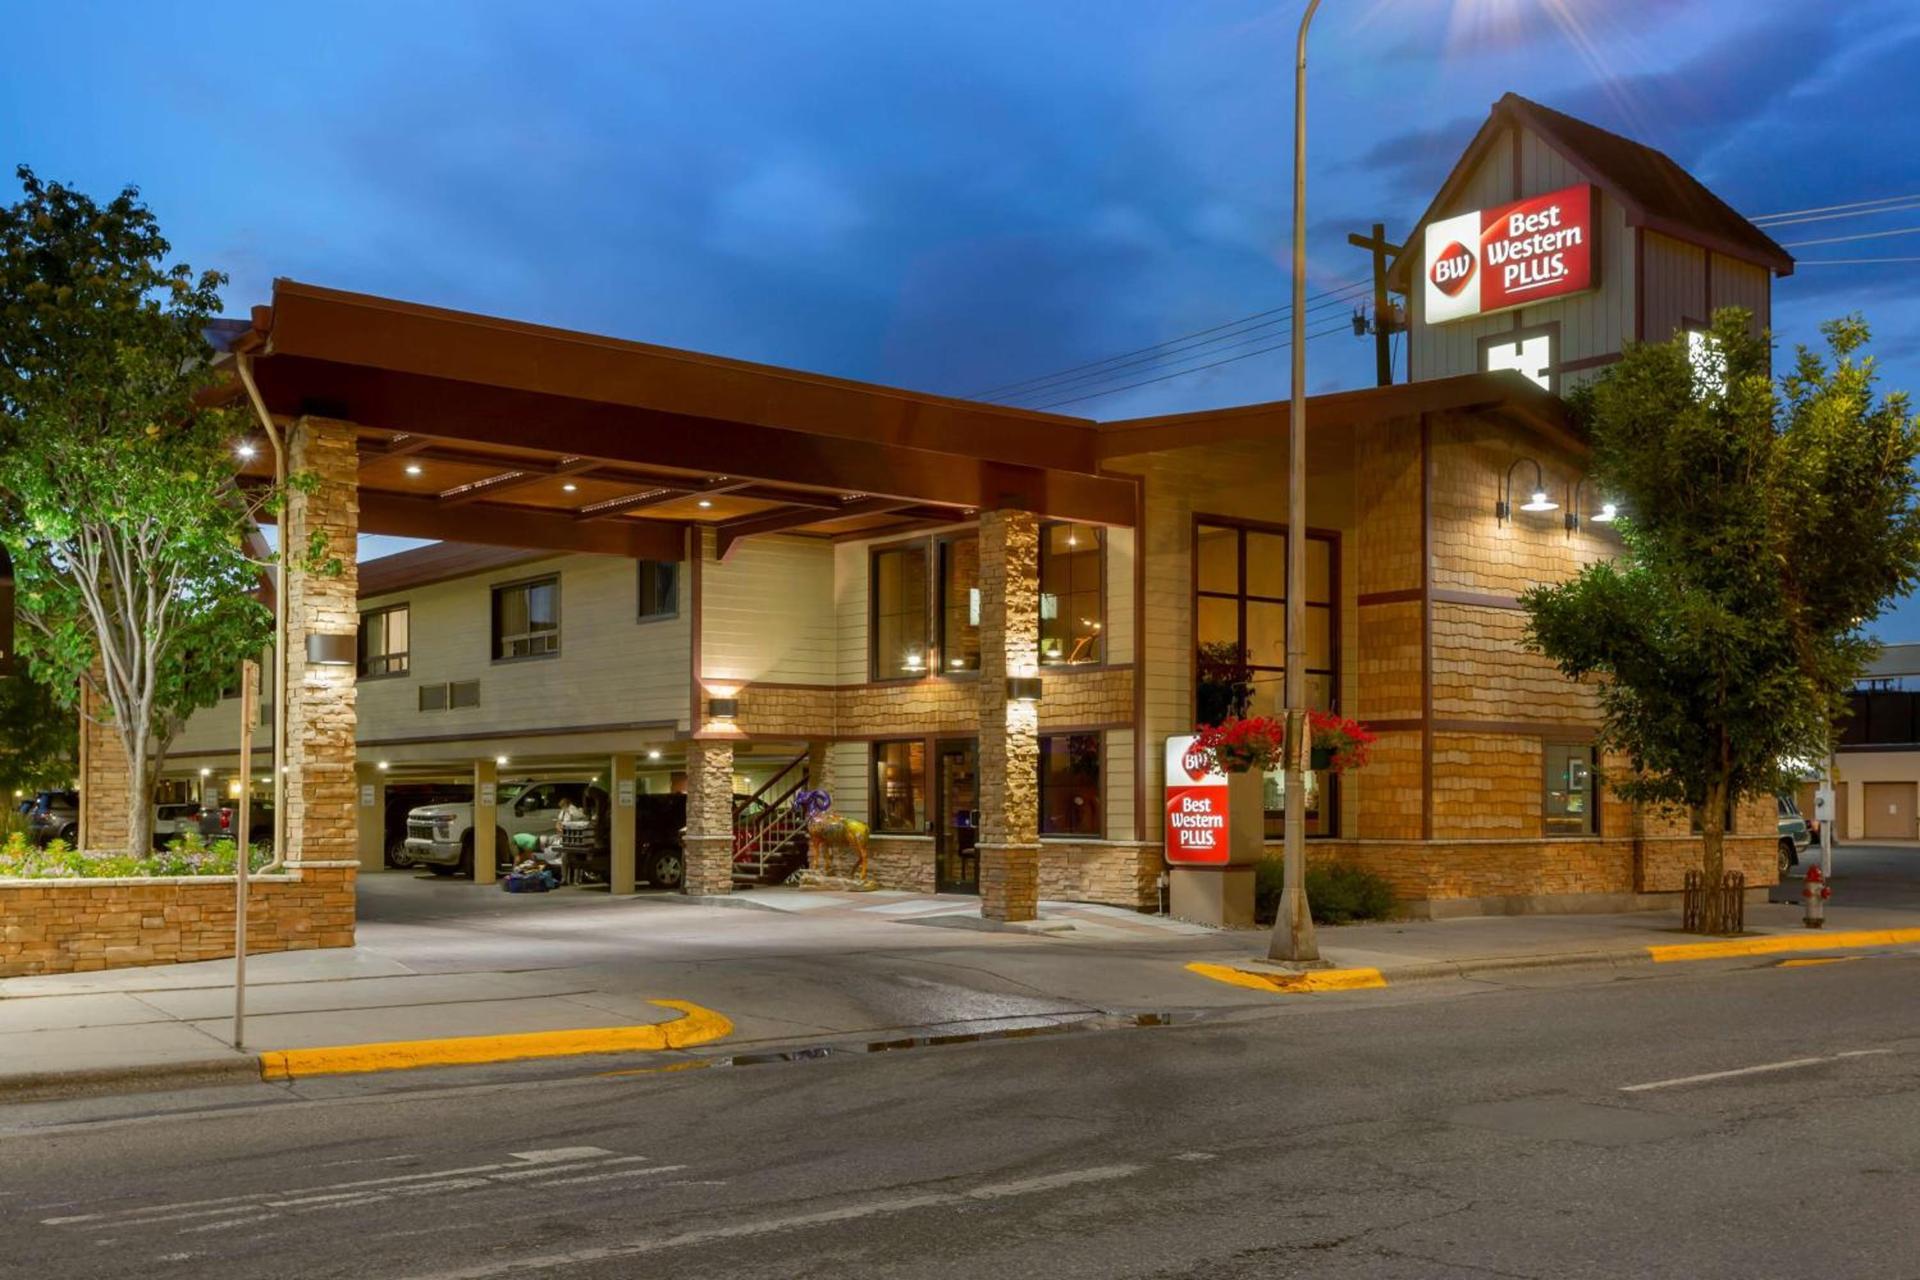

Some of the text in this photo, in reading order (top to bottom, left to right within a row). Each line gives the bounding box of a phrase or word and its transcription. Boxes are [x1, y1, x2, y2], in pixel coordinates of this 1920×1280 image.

[1509, 206, 1560, 237] Best
[1487, 227, 1582, 266] Western
[1435, 255, 1470, 283] BW
[1183, 797, 1212, 812] Best
[1171, 813, 1223, 828] Western
